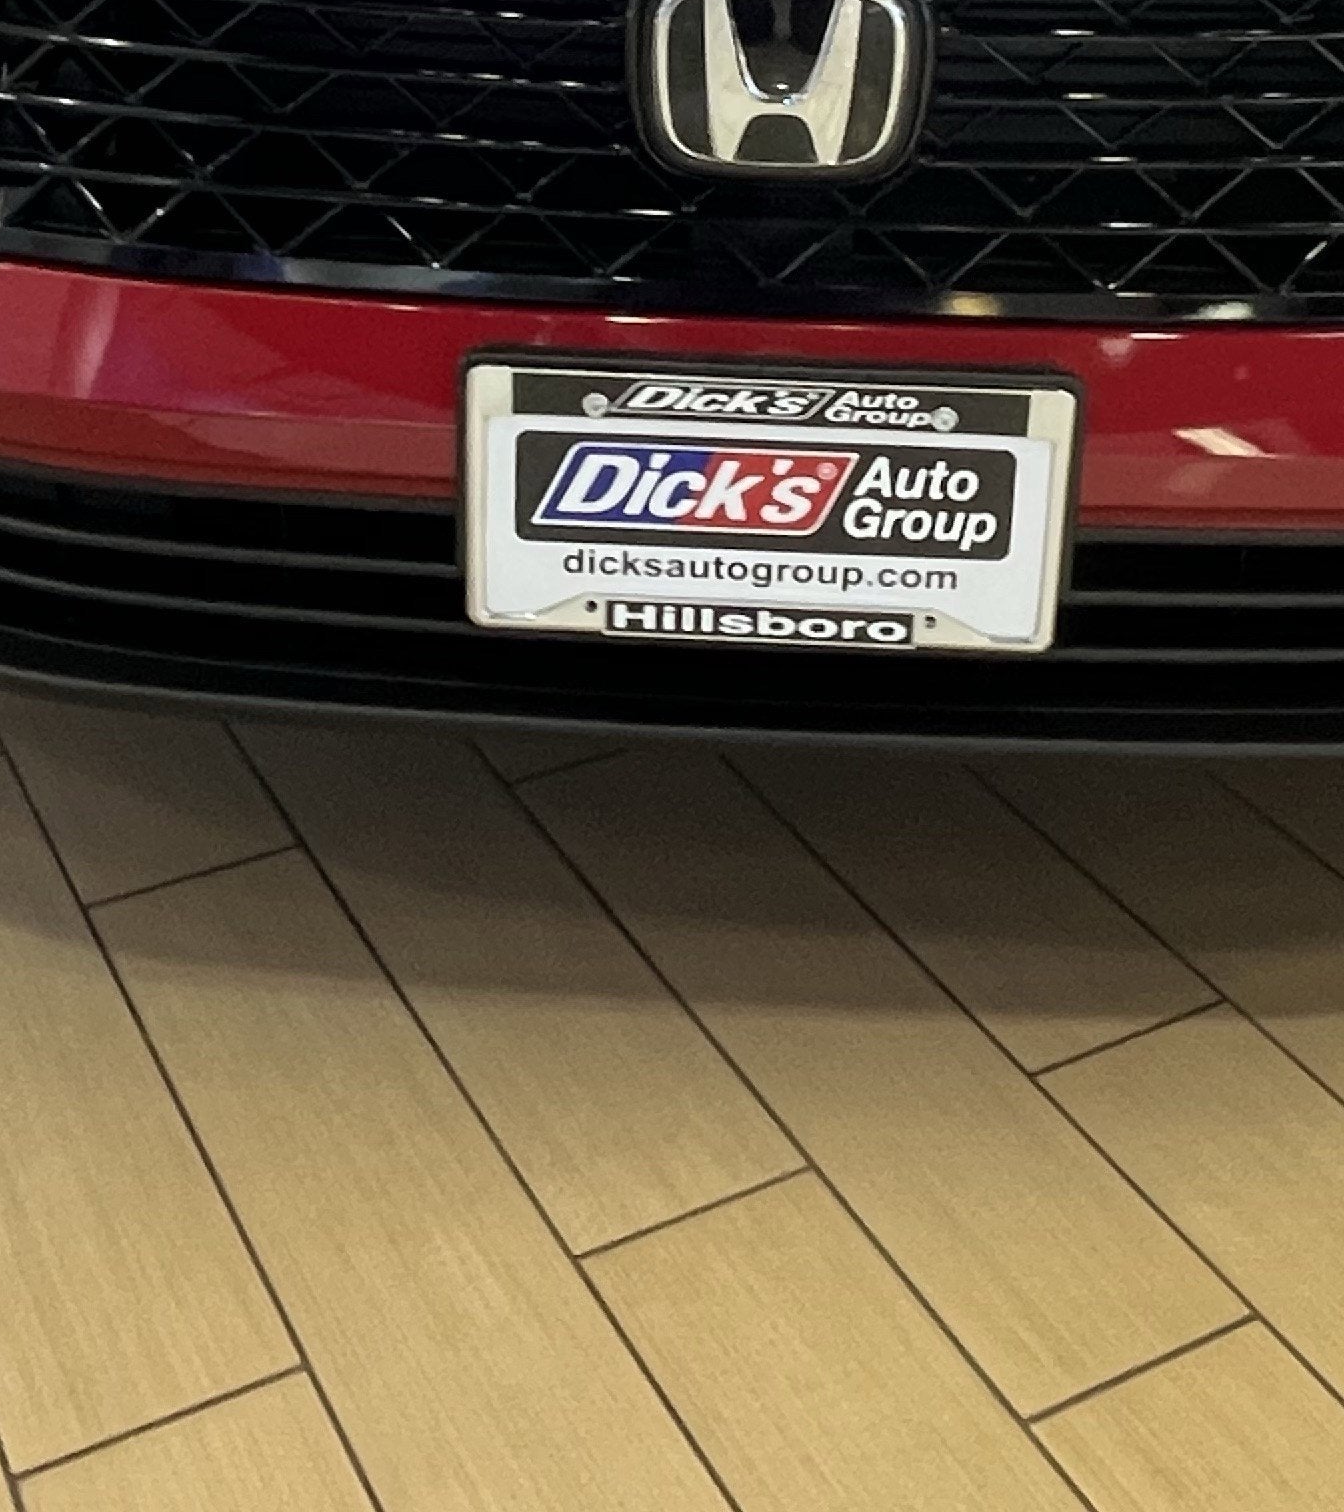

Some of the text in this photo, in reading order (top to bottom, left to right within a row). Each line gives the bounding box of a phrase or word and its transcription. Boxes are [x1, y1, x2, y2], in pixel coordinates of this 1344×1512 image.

[627, 386, 920, 416] Dick's Auto
[824, 407, 934, 429] Group
[556, 451, 980, 525] Dick's Auto
[842, 498, 998, 551] Group
[562, 549, 959, 591] dicksautogroup.com
[611, 602, 910, 644] Hillsboro
